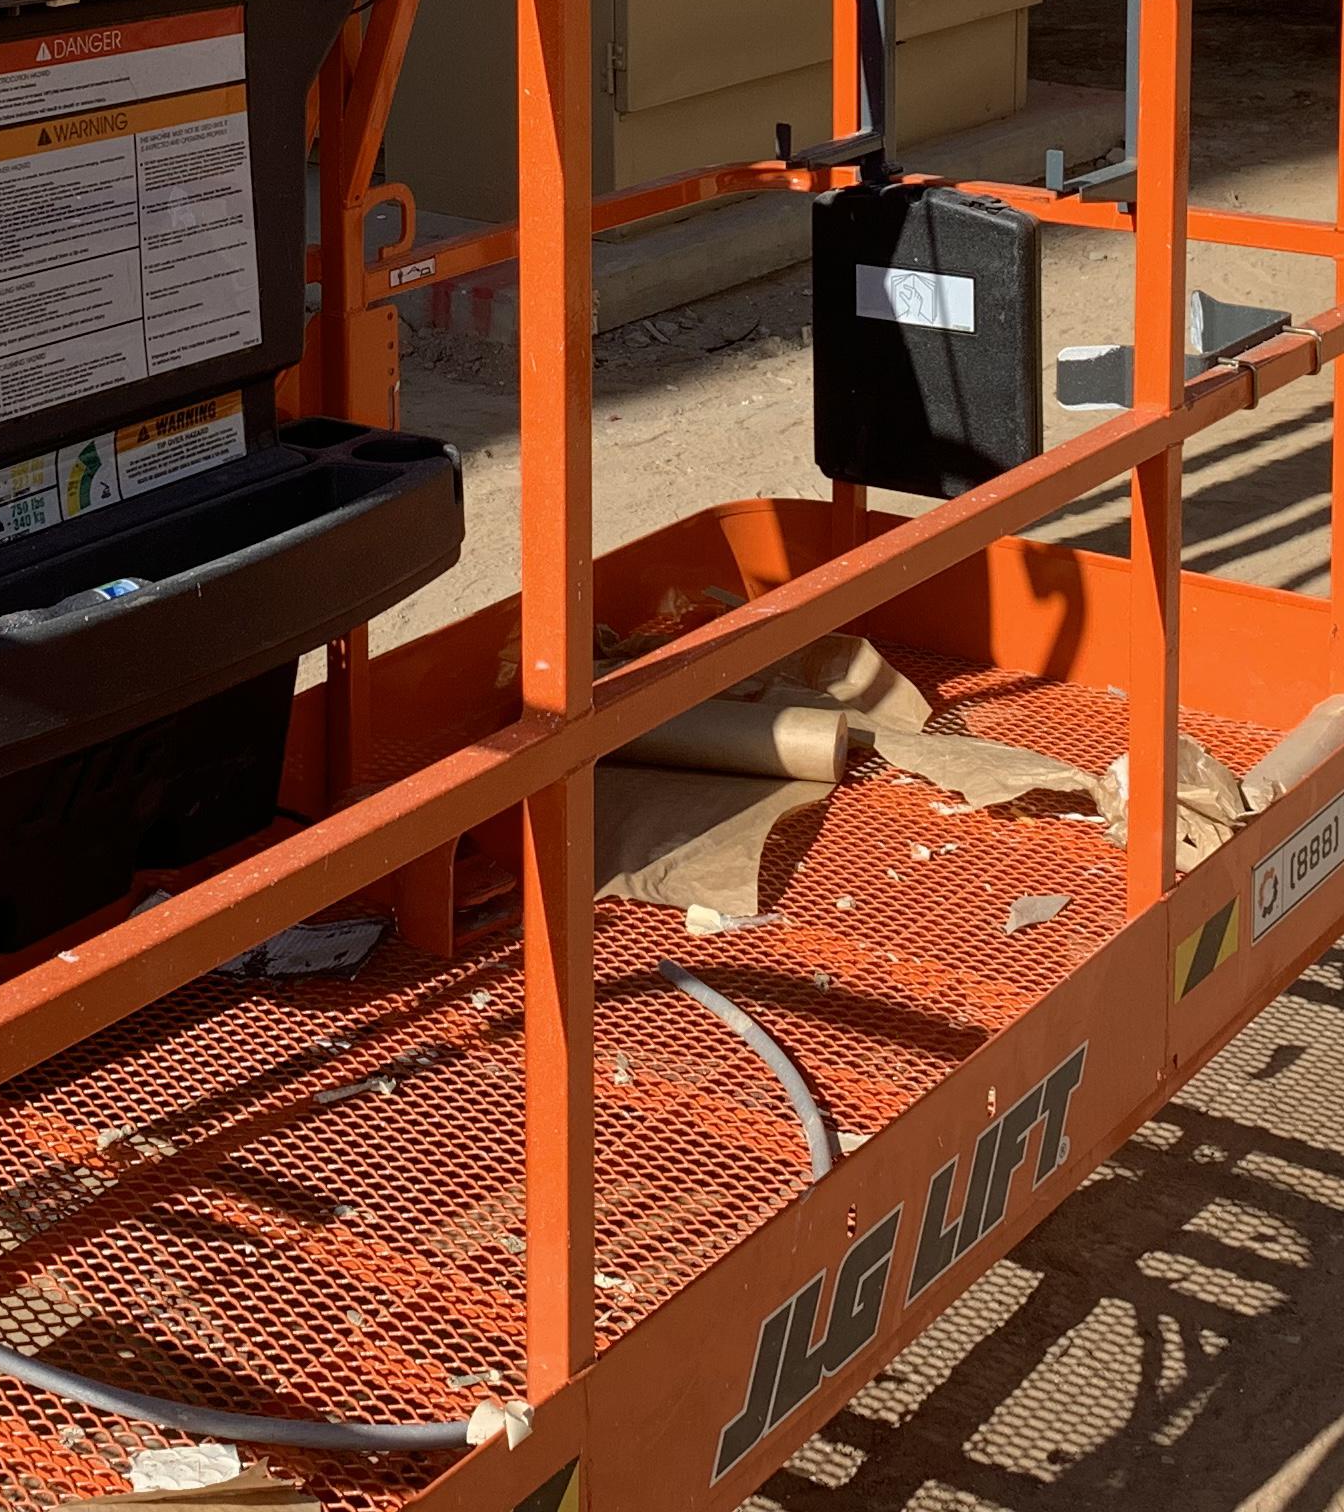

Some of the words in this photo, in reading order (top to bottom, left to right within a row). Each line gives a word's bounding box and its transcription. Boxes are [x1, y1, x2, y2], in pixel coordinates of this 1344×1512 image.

[54, 29, 122, 60] DANGER
[53, 112, 128, 143] WARNING
[156, 400, 217, 436] WARNING
[10, 500, 29, 518] 750
[31, 497, 45, 510] lbs
[12, 515, 31, 531] 340
[33, 510, 46, 525] kg
[1290, 815, 1340, 890] (888)
[709, 1200, 905, 1487] JLG
[903, 1039, 1089, 1311] LIFT
